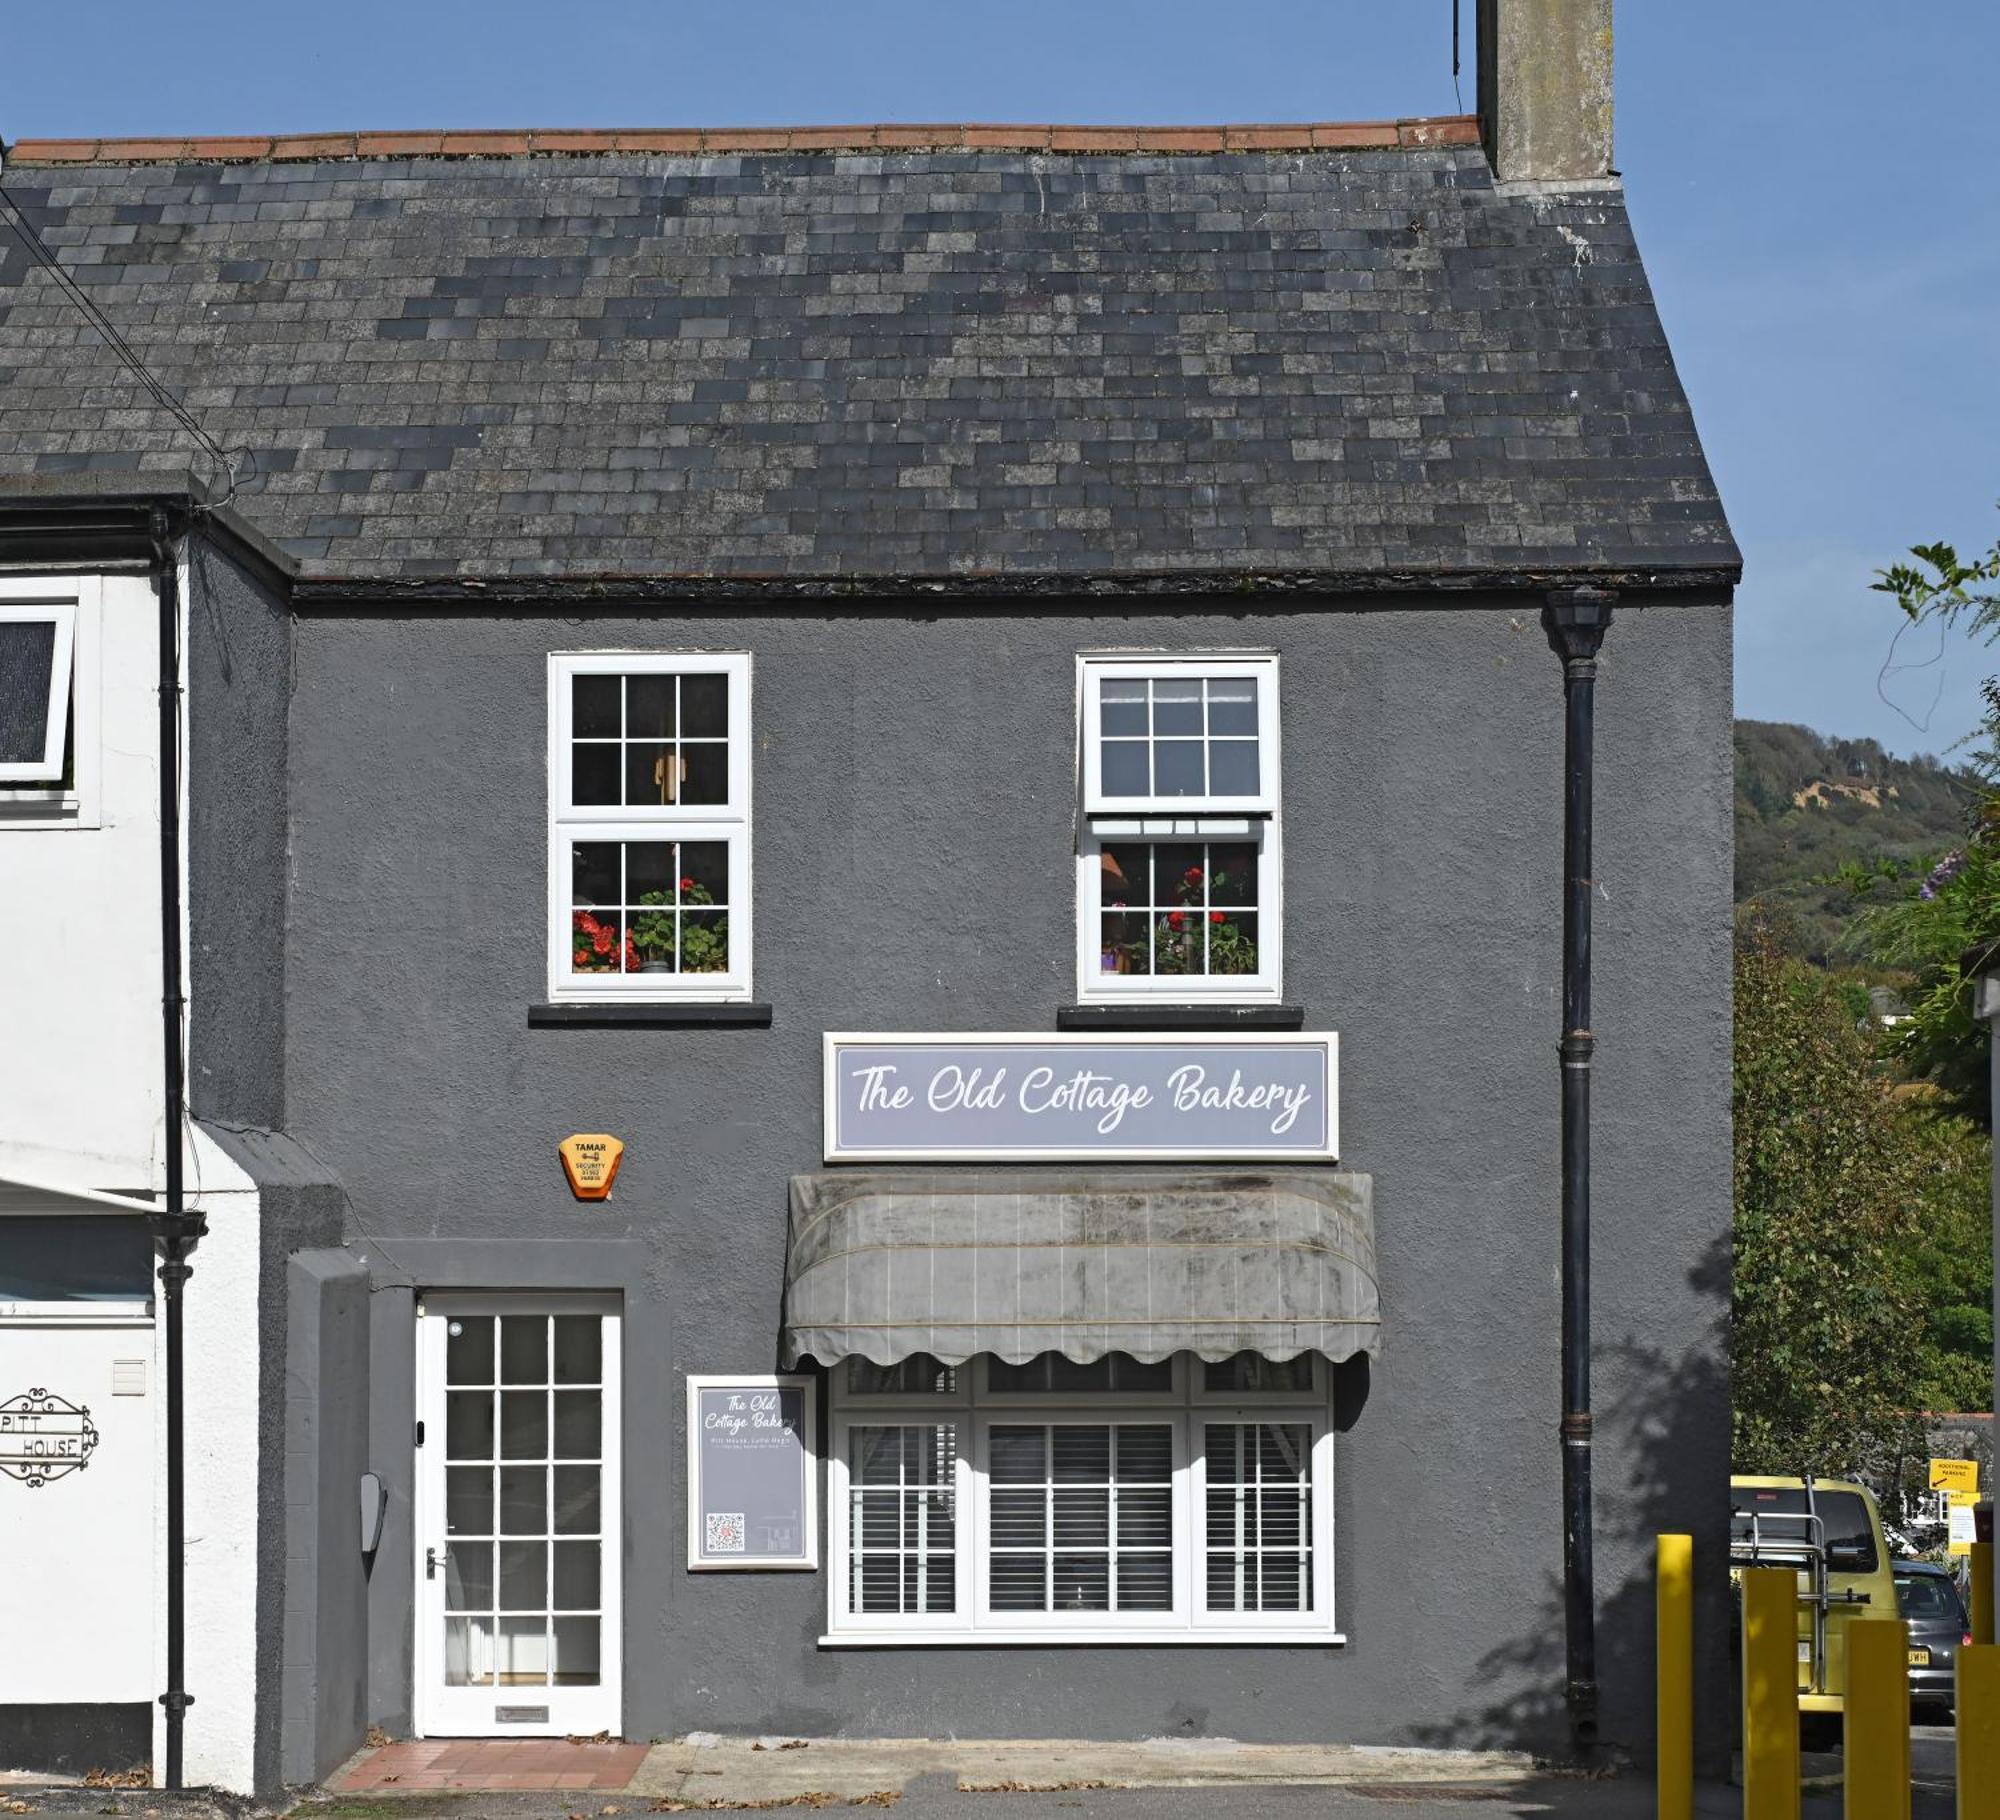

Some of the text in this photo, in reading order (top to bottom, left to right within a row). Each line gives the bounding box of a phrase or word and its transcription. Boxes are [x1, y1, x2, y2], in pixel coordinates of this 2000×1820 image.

[852, 1064, 1312, 1135] The Old Cottage Bakery
[575, 1143, 607, 1151] TAMAR
[726, 1395, 777, 1412] The Old
[2, 1415, 42, 1432] PITT
[704, 1411, 797, 1436] Cottage Bakery
[23, 1439, 77, 1457] HOUSE
